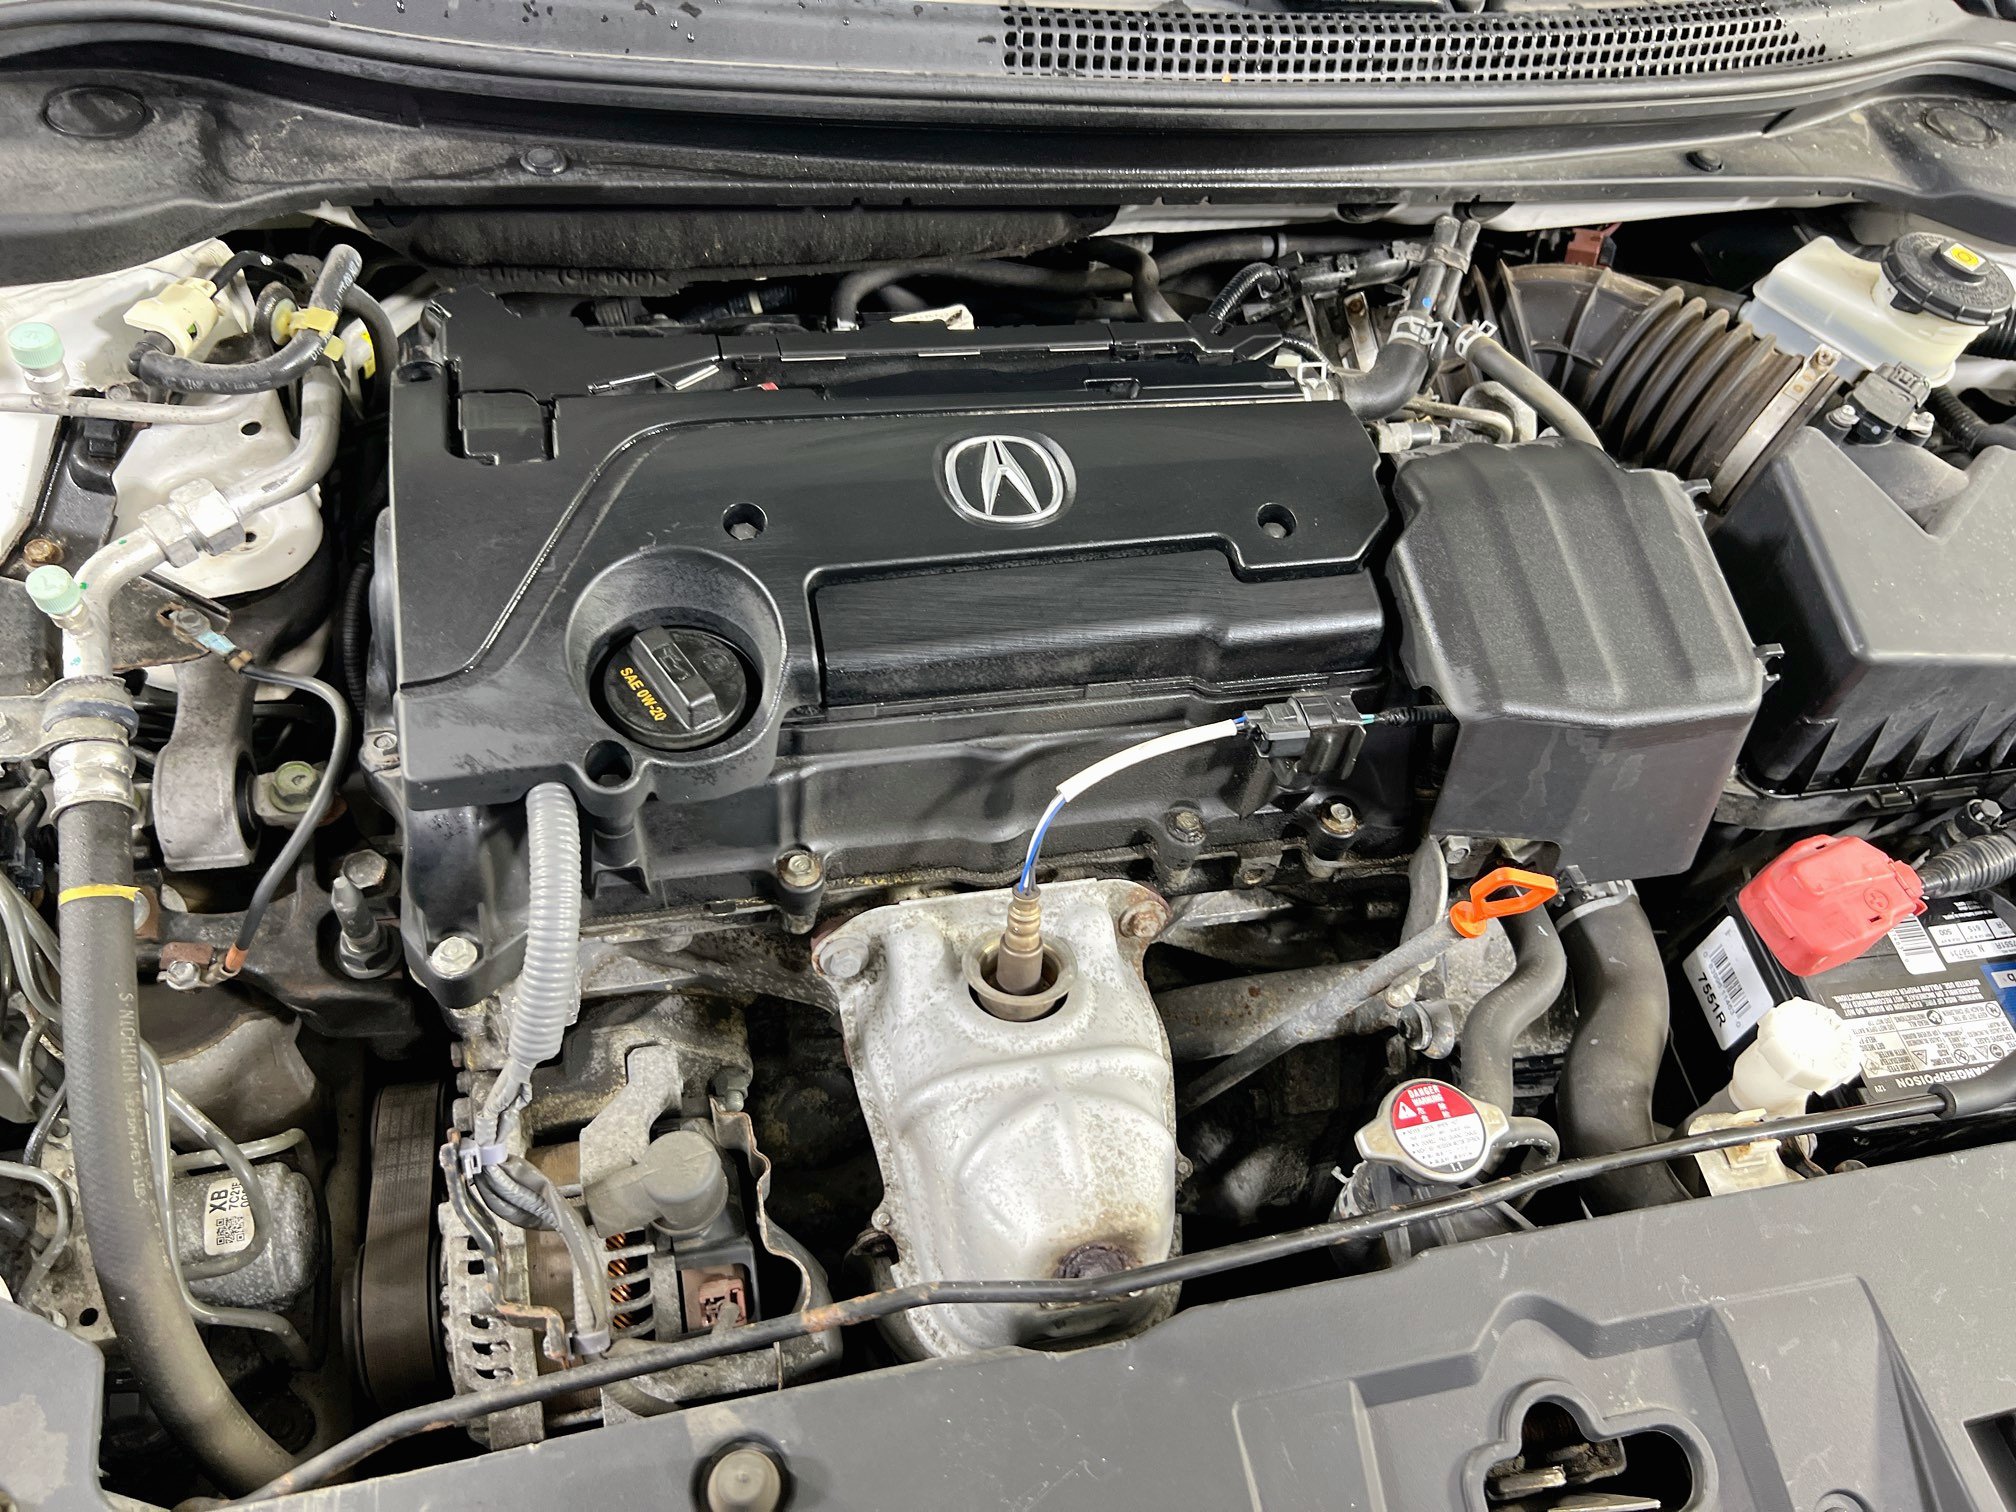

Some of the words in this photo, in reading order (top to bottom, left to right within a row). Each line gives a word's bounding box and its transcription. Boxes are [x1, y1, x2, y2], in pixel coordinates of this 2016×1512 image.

[620, 667, 645, 691] SAE
[636, 689, 668, 722] 0W-20
[1697, 971, 1726, 1028] 7551R
[1407, 1085, 1440, 1098] DANGER
[1873, 1084, 1886, 1092] 12V
[209, 1189, 229, 1214] XB
